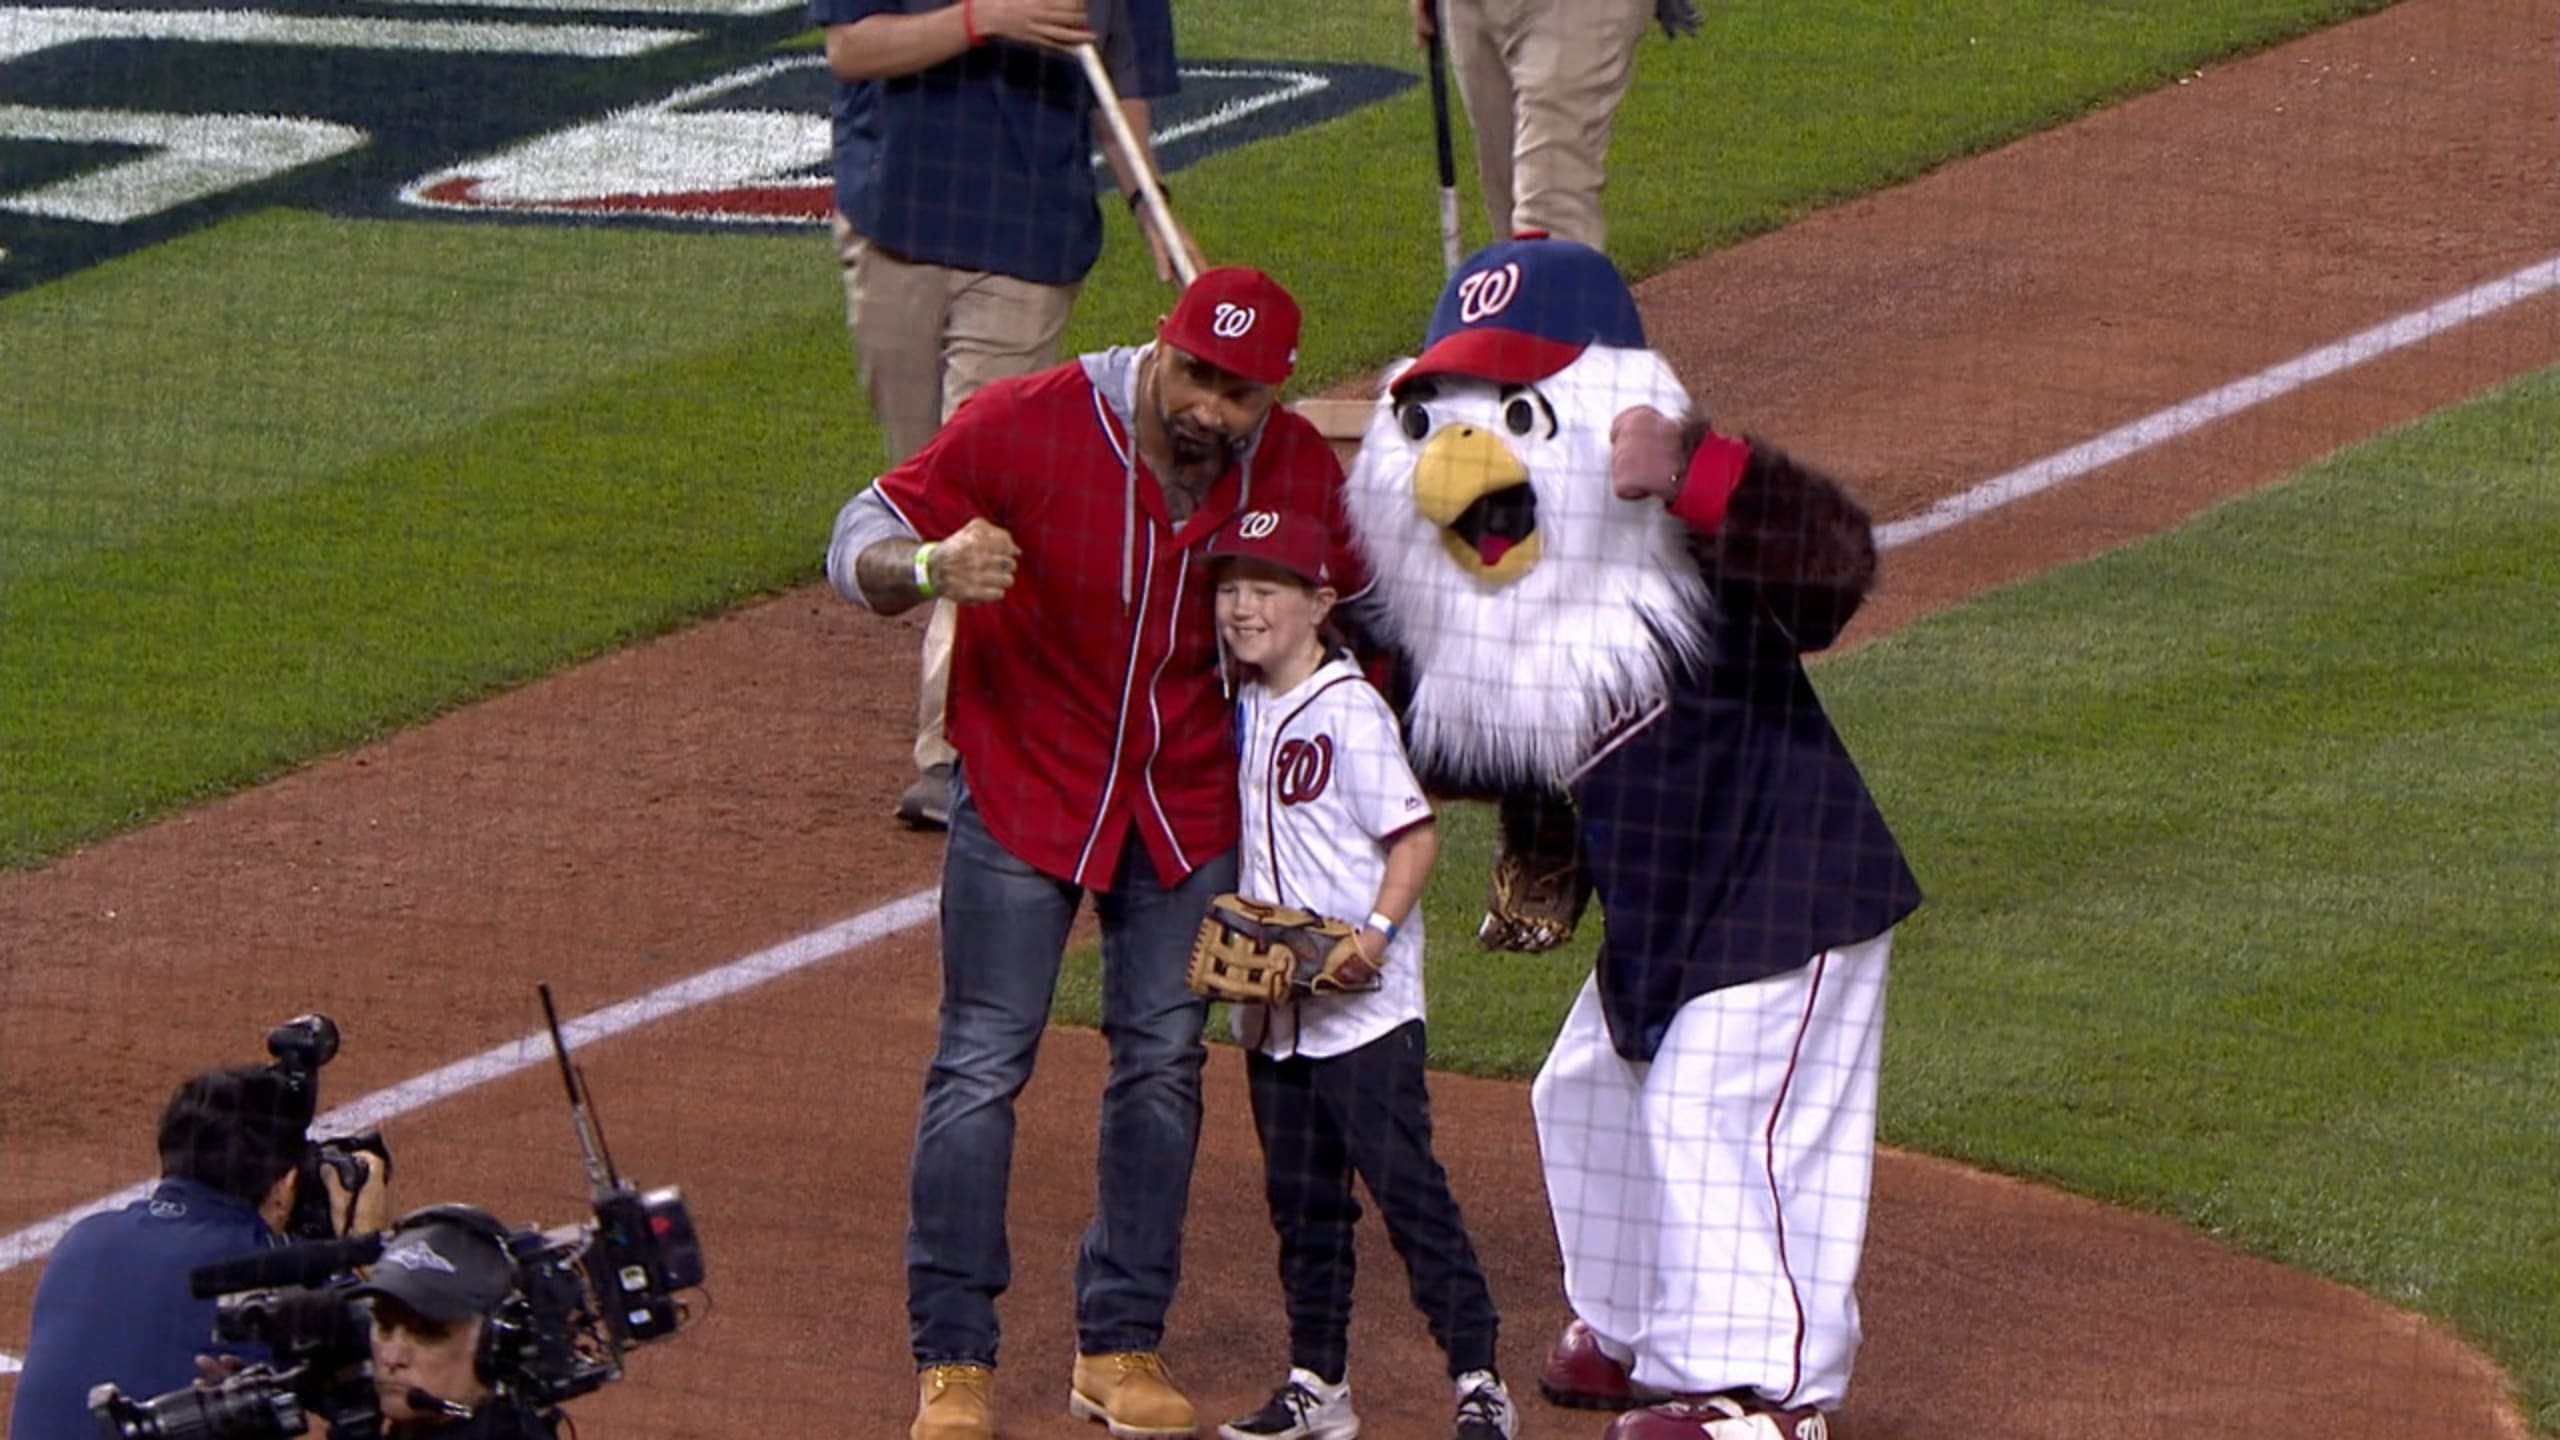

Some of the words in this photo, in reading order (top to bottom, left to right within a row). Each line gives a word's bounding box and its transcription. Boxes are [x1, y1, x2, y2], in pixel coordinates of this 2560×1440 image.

[1457, 261, 1521, 325] W
[1212, 302, 1256, 338] W
[1238, 511, 1280, 539] W
[1276, 733, 1334, 806] W
